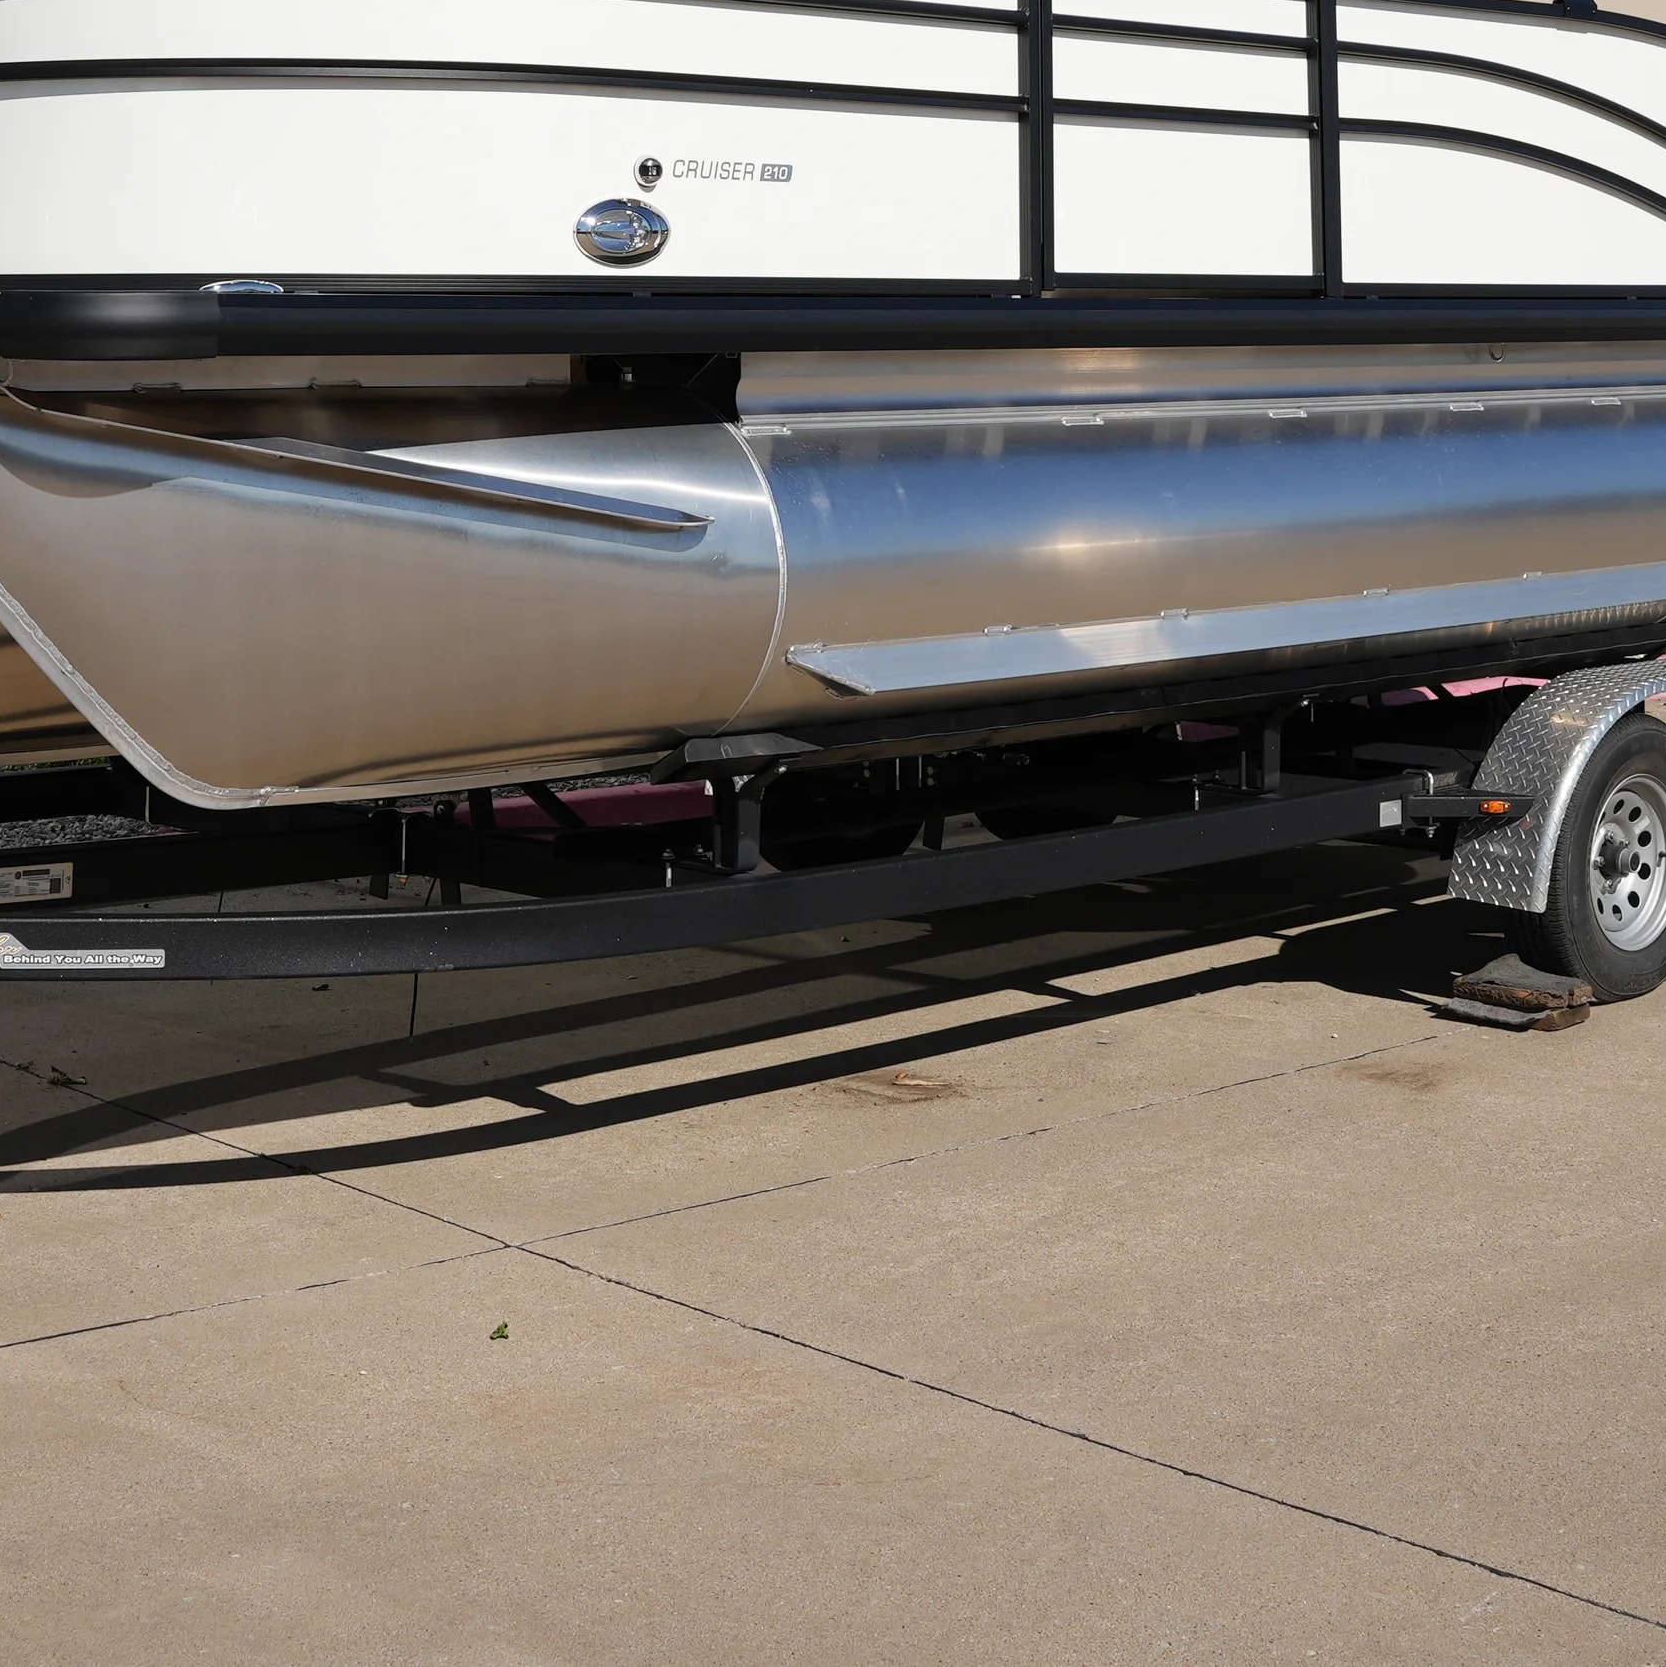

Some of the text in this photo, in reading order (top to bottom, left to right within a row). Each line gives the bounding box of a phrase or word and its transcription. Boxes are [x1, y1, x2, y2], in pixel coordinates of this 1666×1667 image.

[672, 159, 790, 181] CRUISER 210
[3, 954, 162, 965] Behind You All the Way
